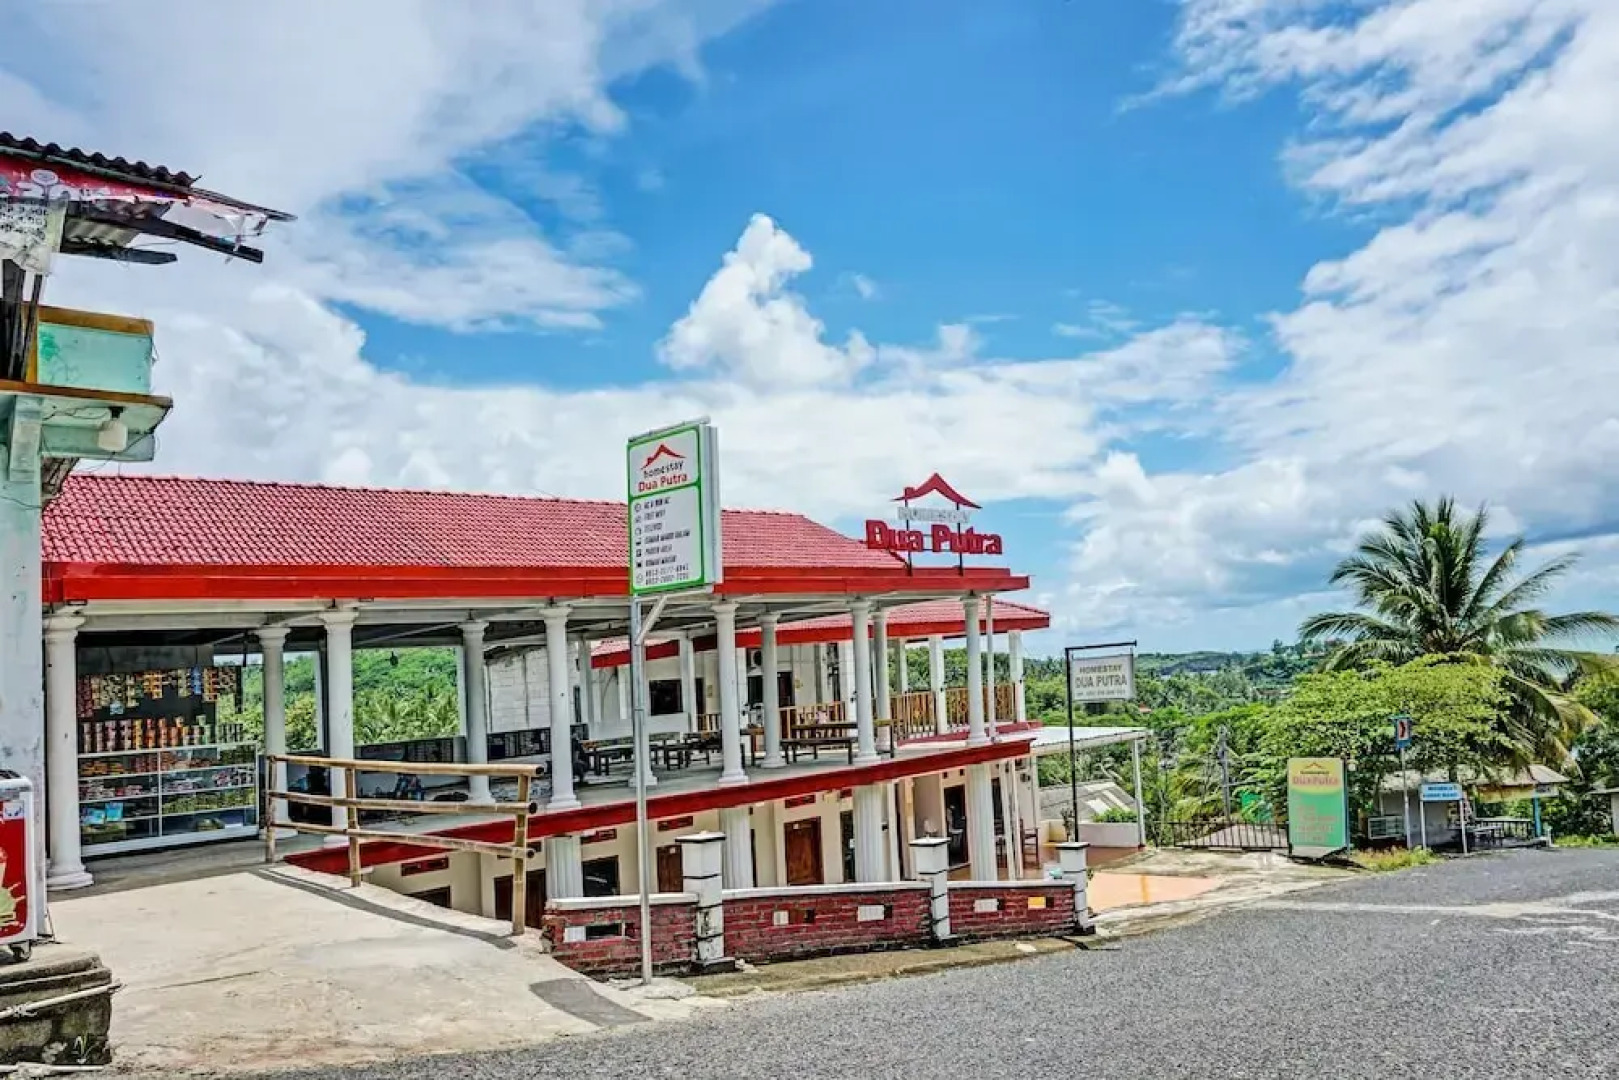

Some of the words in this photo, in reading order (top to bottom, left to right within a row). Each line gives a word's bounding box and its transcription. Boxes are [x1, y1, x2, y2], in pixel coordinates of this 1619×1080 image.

[643, 460, 684, 479] homestay
[638, 480, 658, 492] Dua
[660, 474, 687, 487] Putra
[866, 520, 923, 552] Dua
[931, 524, 1002, 555] Putra
[1079, 664, 1122, 674] HOMESTAY
[1075, 676, 1094, 688] DUA
[1096, 674, 1127, 687] PUTRA
